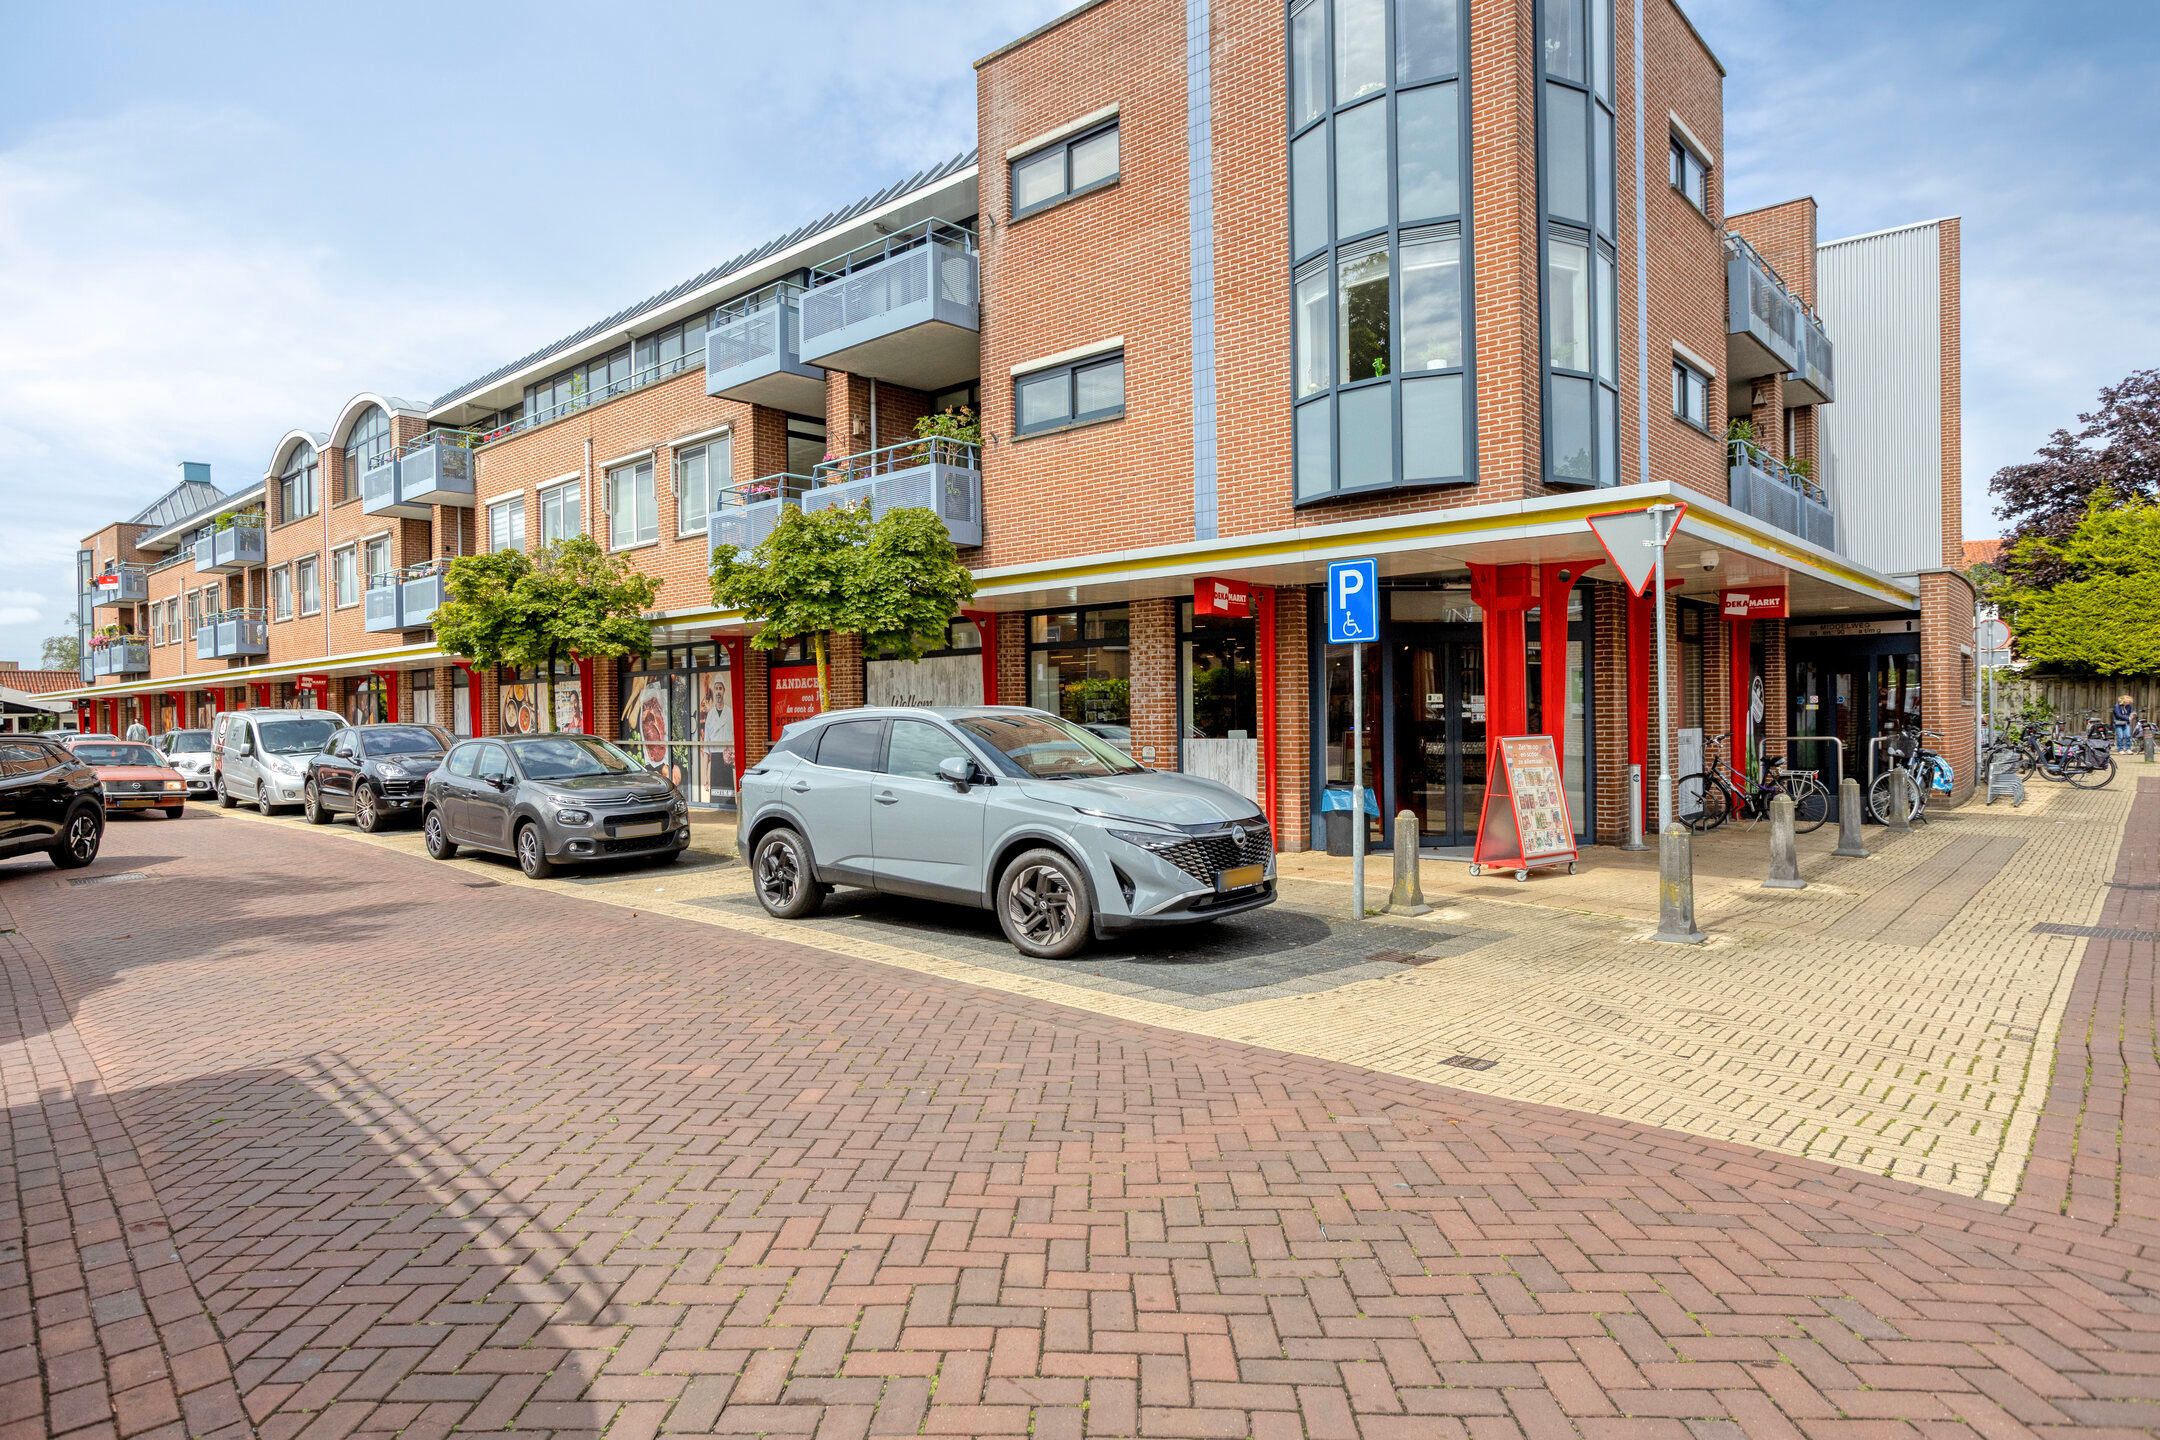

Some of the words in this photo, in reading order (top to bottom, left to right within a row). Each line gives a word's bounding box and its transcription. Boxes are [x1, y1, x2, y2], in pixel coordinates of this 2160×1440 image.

[1339, 569, 1364, 609] P
[1726, 598, 1780, 608] DEKAMARKT
[1820, 622, 1871, 630] MIDDELWEG
[776, 678, 819, 690] AANDACH
